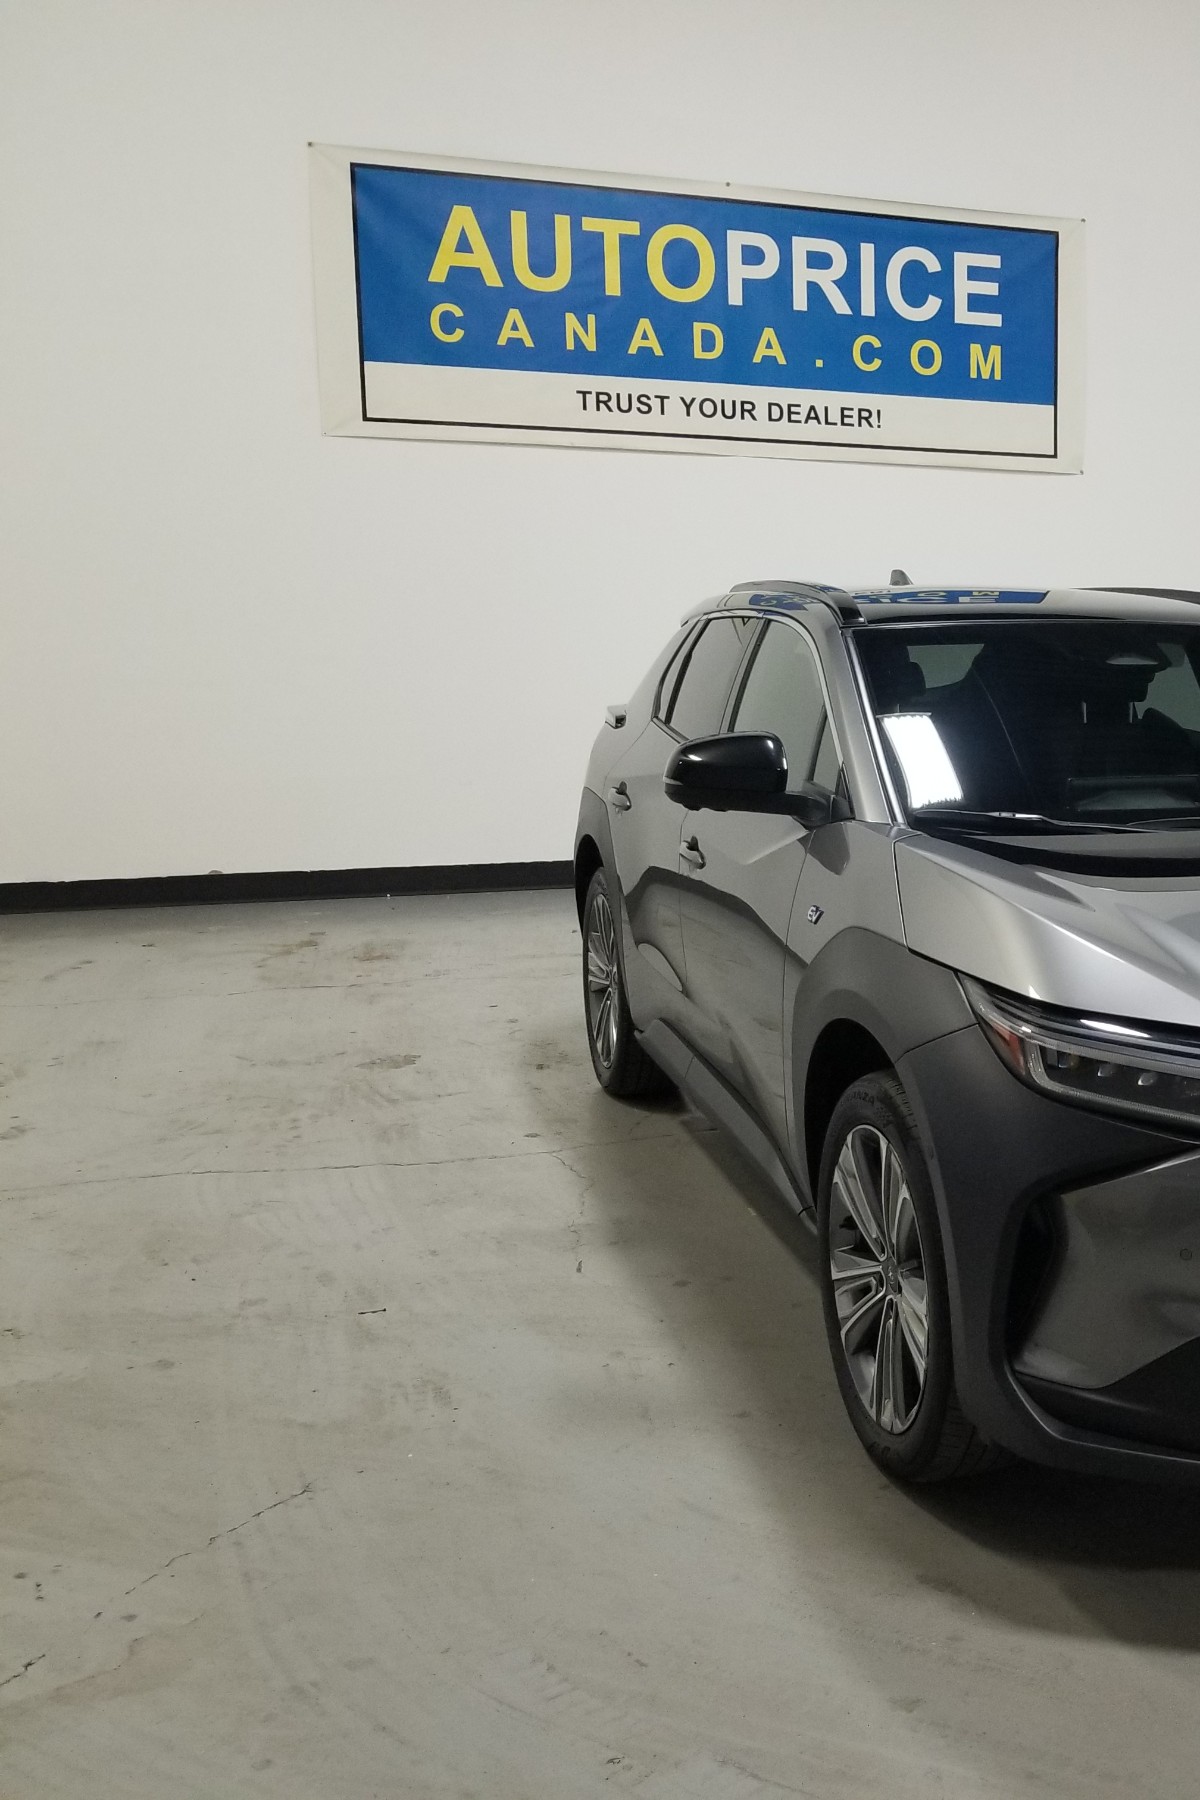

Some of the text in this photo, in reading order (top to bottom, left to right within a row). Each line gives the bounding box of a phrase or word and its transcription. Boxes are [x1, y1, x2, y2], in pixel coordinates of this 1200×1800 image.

[427, 205, 1003, 327] AUTOPRICE
[429, 302, 1003, 380] CANADA.COM
[576, 390, 882, 429] TRUST YOUR DEALER!
